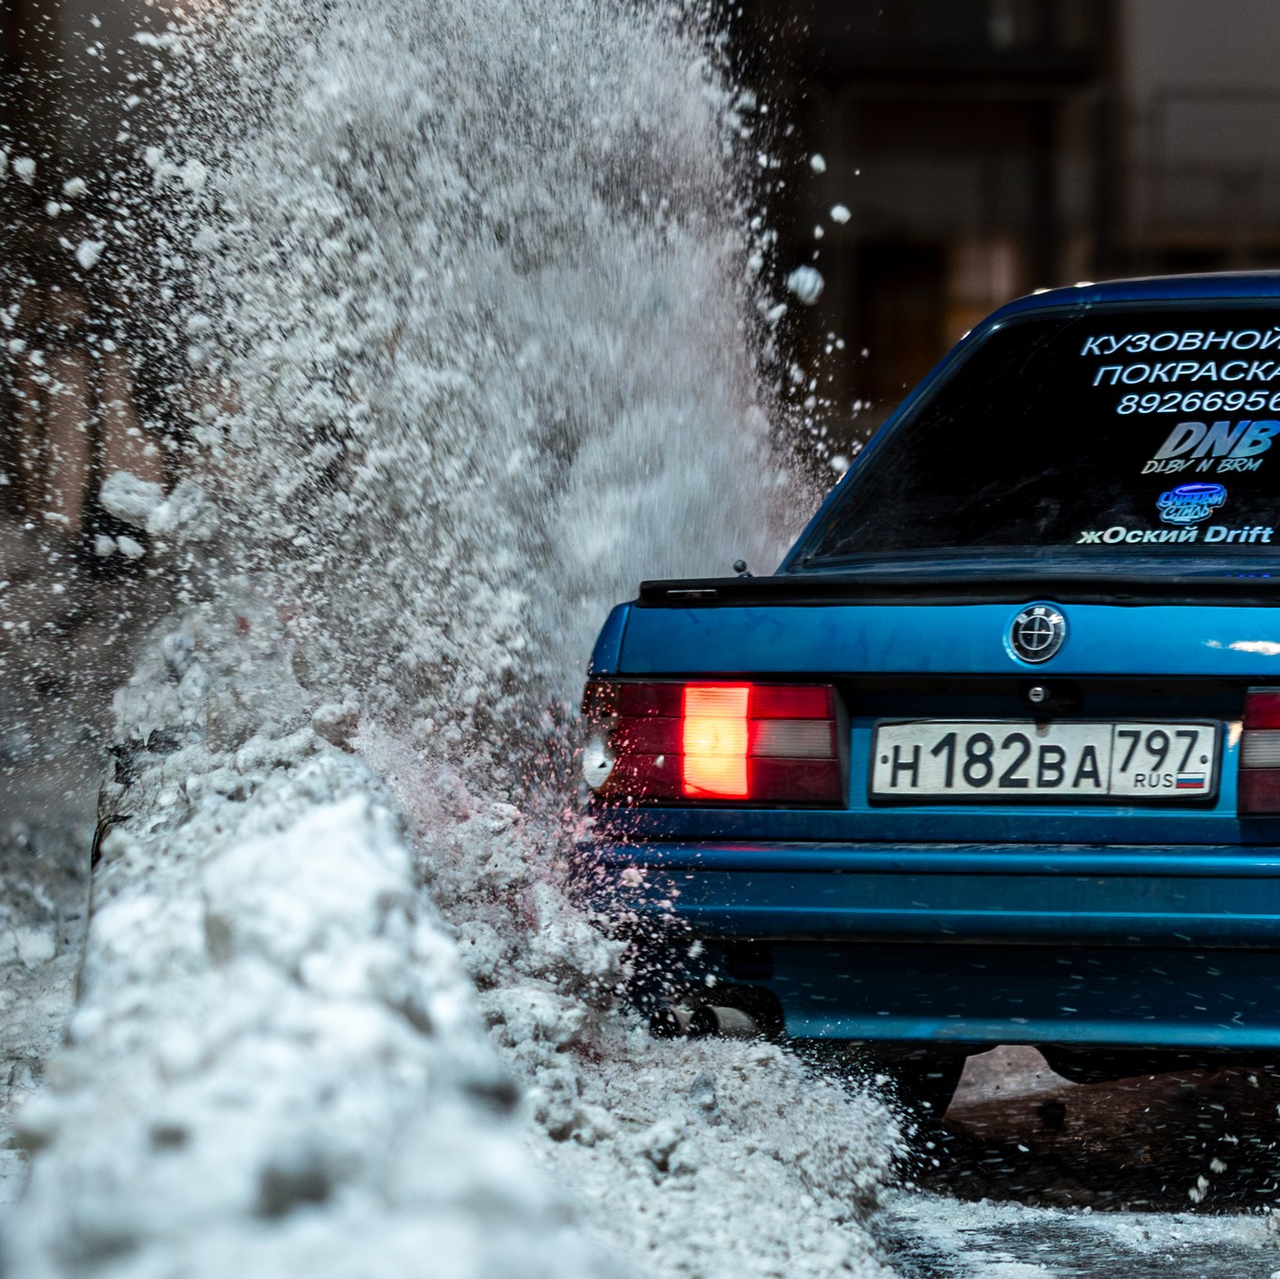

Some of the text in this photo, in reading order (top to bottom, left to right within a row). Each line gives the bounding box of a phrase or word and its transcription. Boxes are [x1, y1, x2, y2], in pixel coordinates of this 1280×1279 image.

[1195, 459, 1215, 472] N
[1217, 458, 1264, 473] BRM
[1077, 525, 1275, 544] жОский Drift
[891, 729, 1200, 788] Н182ВА 797
[1133, 773, 1174, 788] RUS
